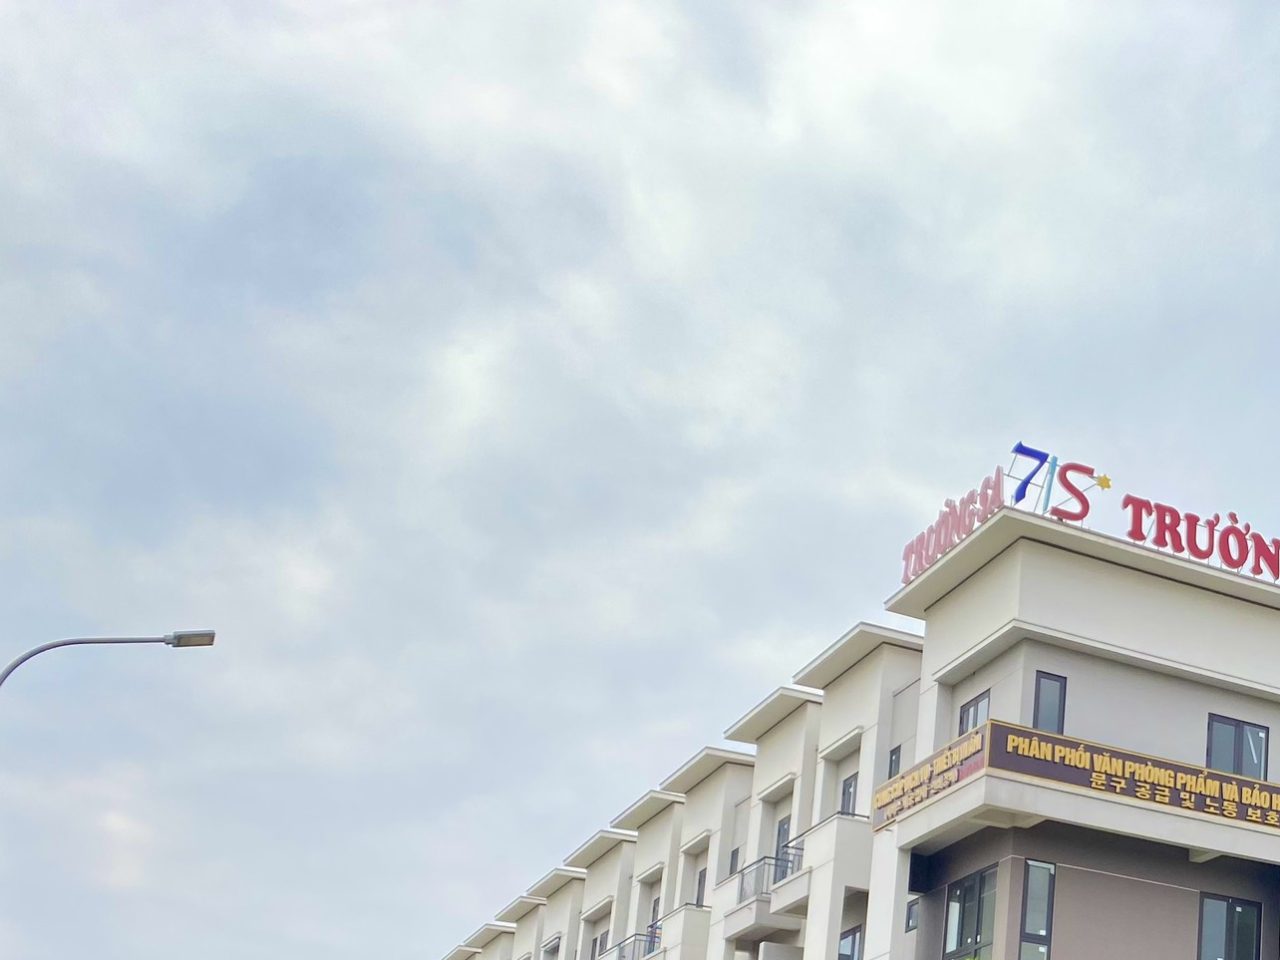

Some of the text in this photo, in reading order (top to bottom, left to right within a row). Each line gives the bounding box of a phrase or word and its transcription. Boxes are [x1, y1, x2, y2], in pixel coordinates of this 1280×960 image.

[1007, 734, 1052, 761] PHÂN
[1054, 744, 1090, 769] PHỐI
[1092, 752, 1123, 776] VĂN
[1125, 761, 1174, 787] PHÒNG
[1176, 768, 1220, 798] PHẨM
[1222, 781, 1238, 802] VÀ
[1241, 784, 1270, 810] BẢO
[1090, 772, 1127, 793] 문구
[1135, 782, 1170, 803] 공급
[1204, 798, 1237, 818] 노동
[1246, 809, 1280, 826] 보호
